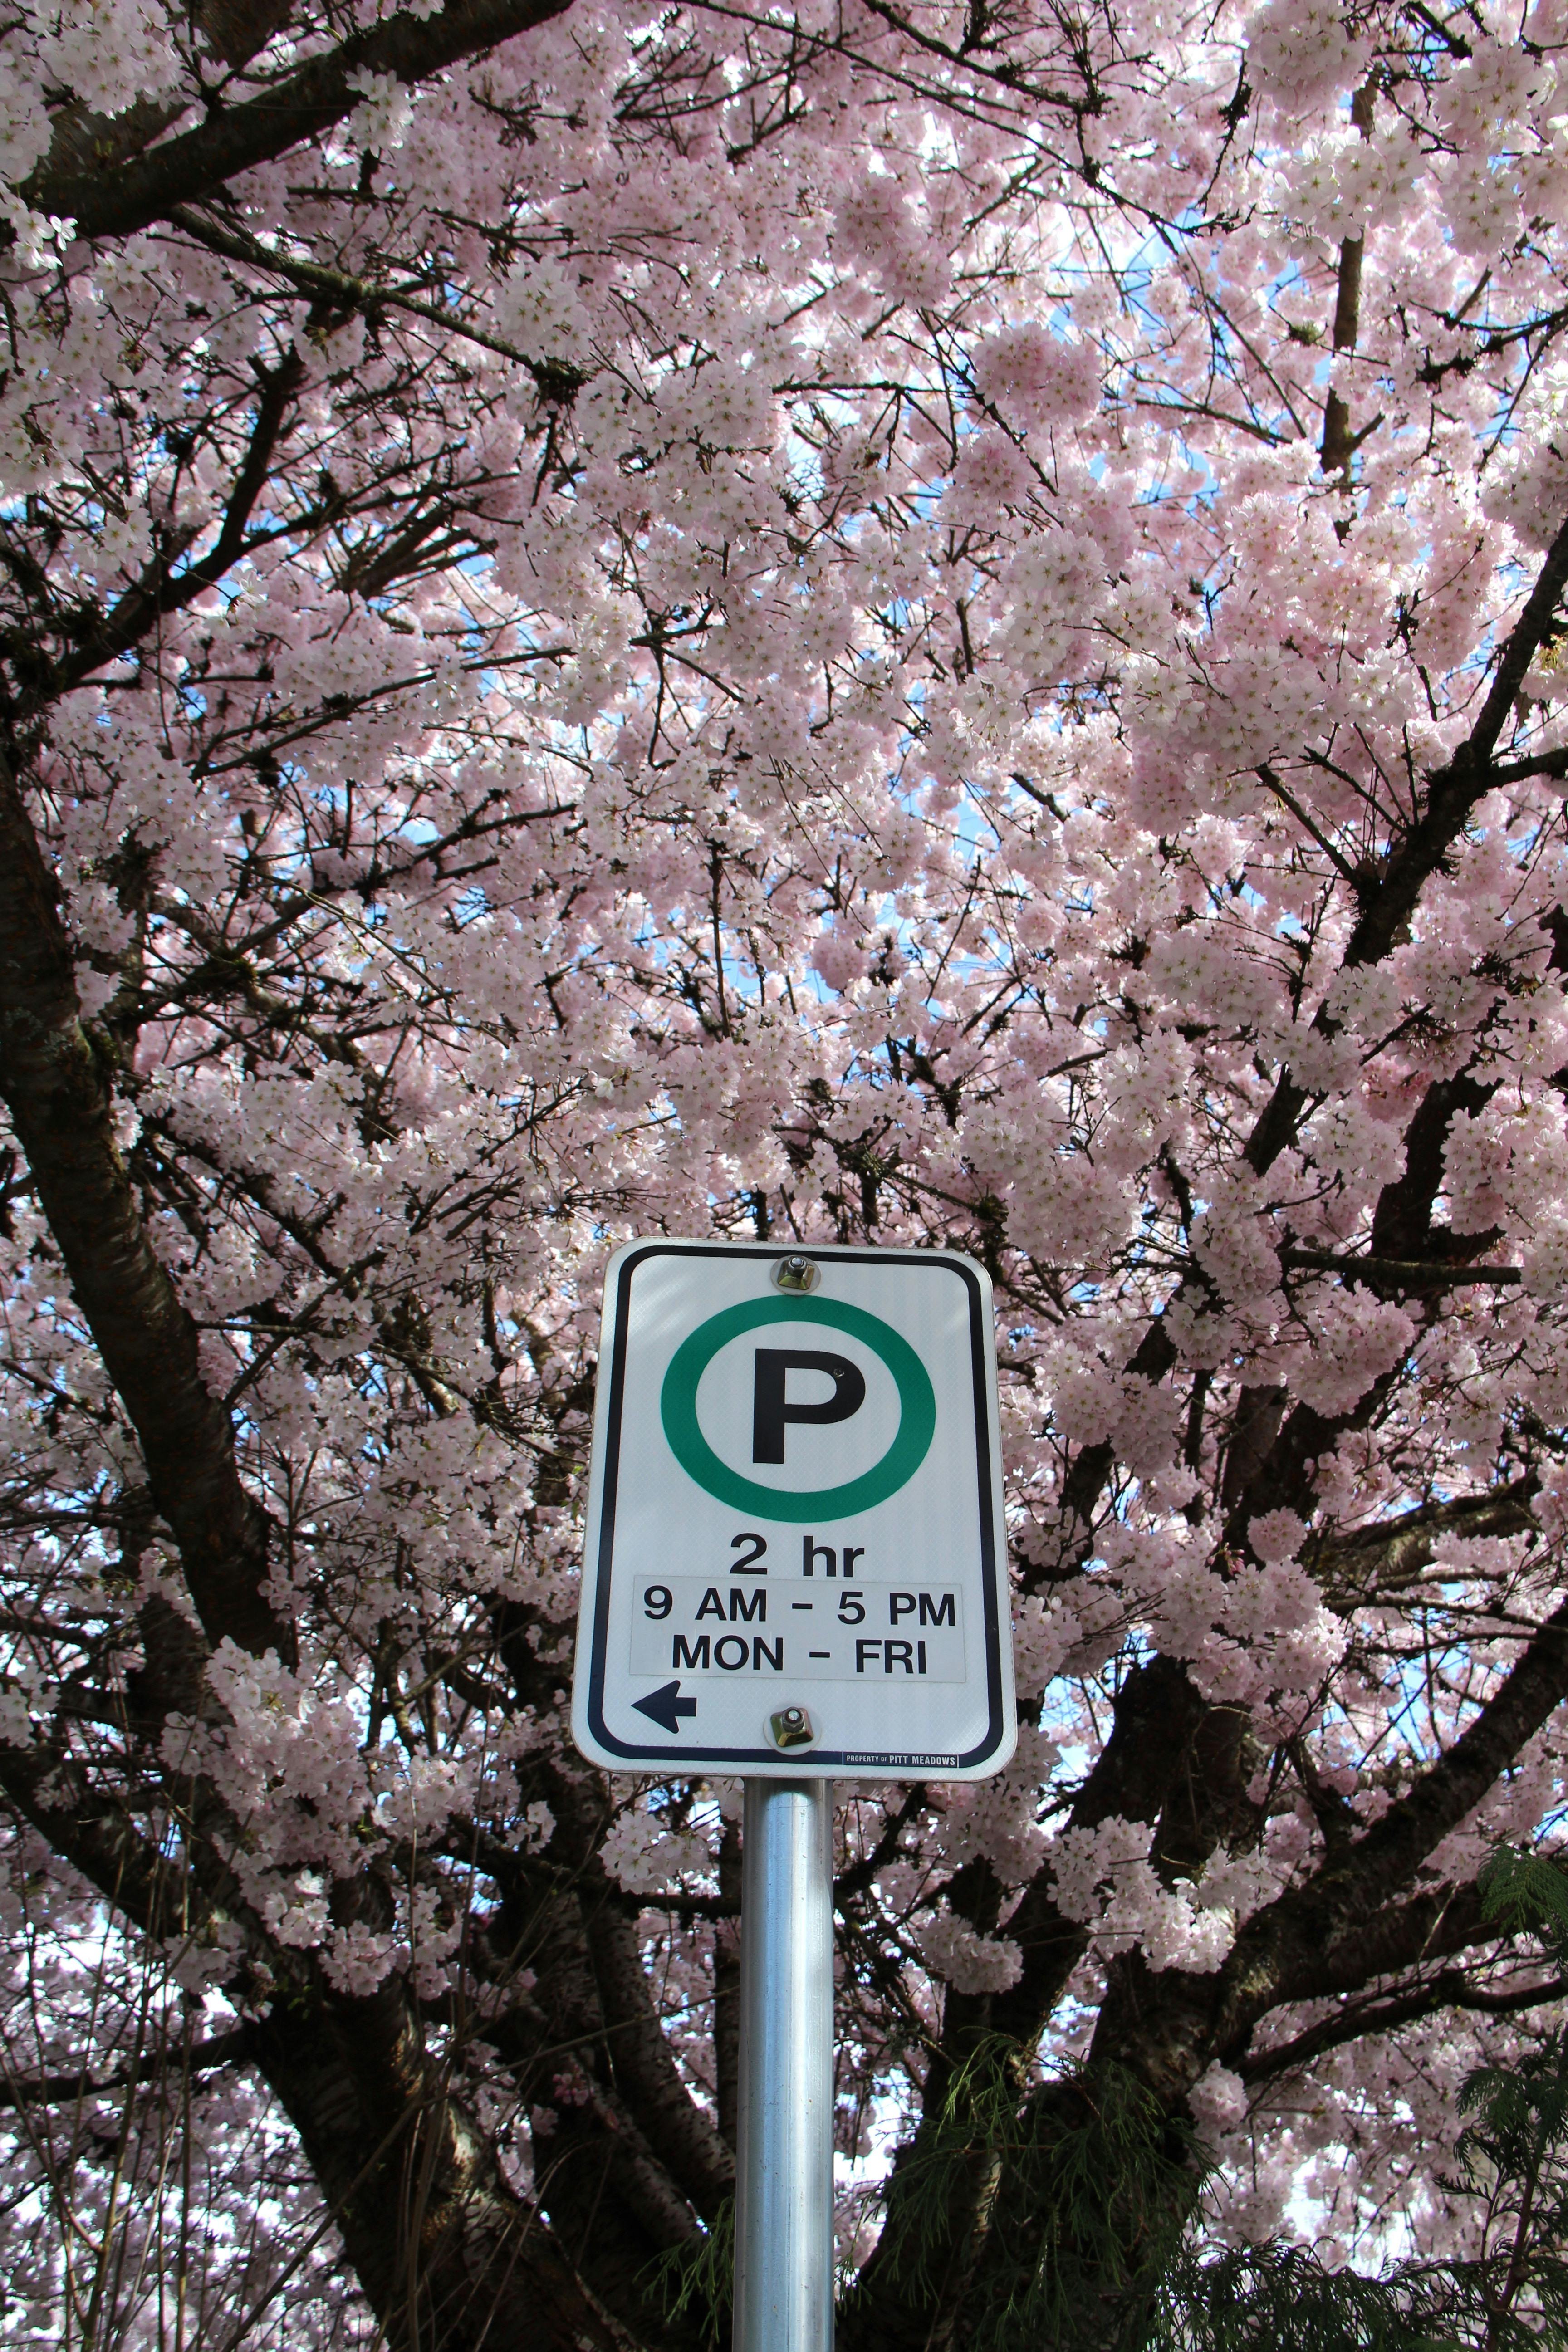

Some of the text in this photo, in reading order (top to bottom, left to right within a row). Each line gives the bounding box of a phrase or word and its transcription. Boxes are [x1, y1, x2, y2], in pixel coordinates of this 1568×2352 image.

[753, 1349, 865, 1464] P
[730, 1533, 864, 1577] 2 hr
[644, 1585, 672, 1619] 9
[695, 1588, 766, 1622] AM
[838, 1592, 865, 1624] 5
[890, 1593, 955, 1626] PM
[673, 1635, 783, 1671] MON
[856, 1640, 926, 1674] FRI
[889, 1755, 908, 1764] PITT
[912, 1756, 955, 1765] MEADOWS
